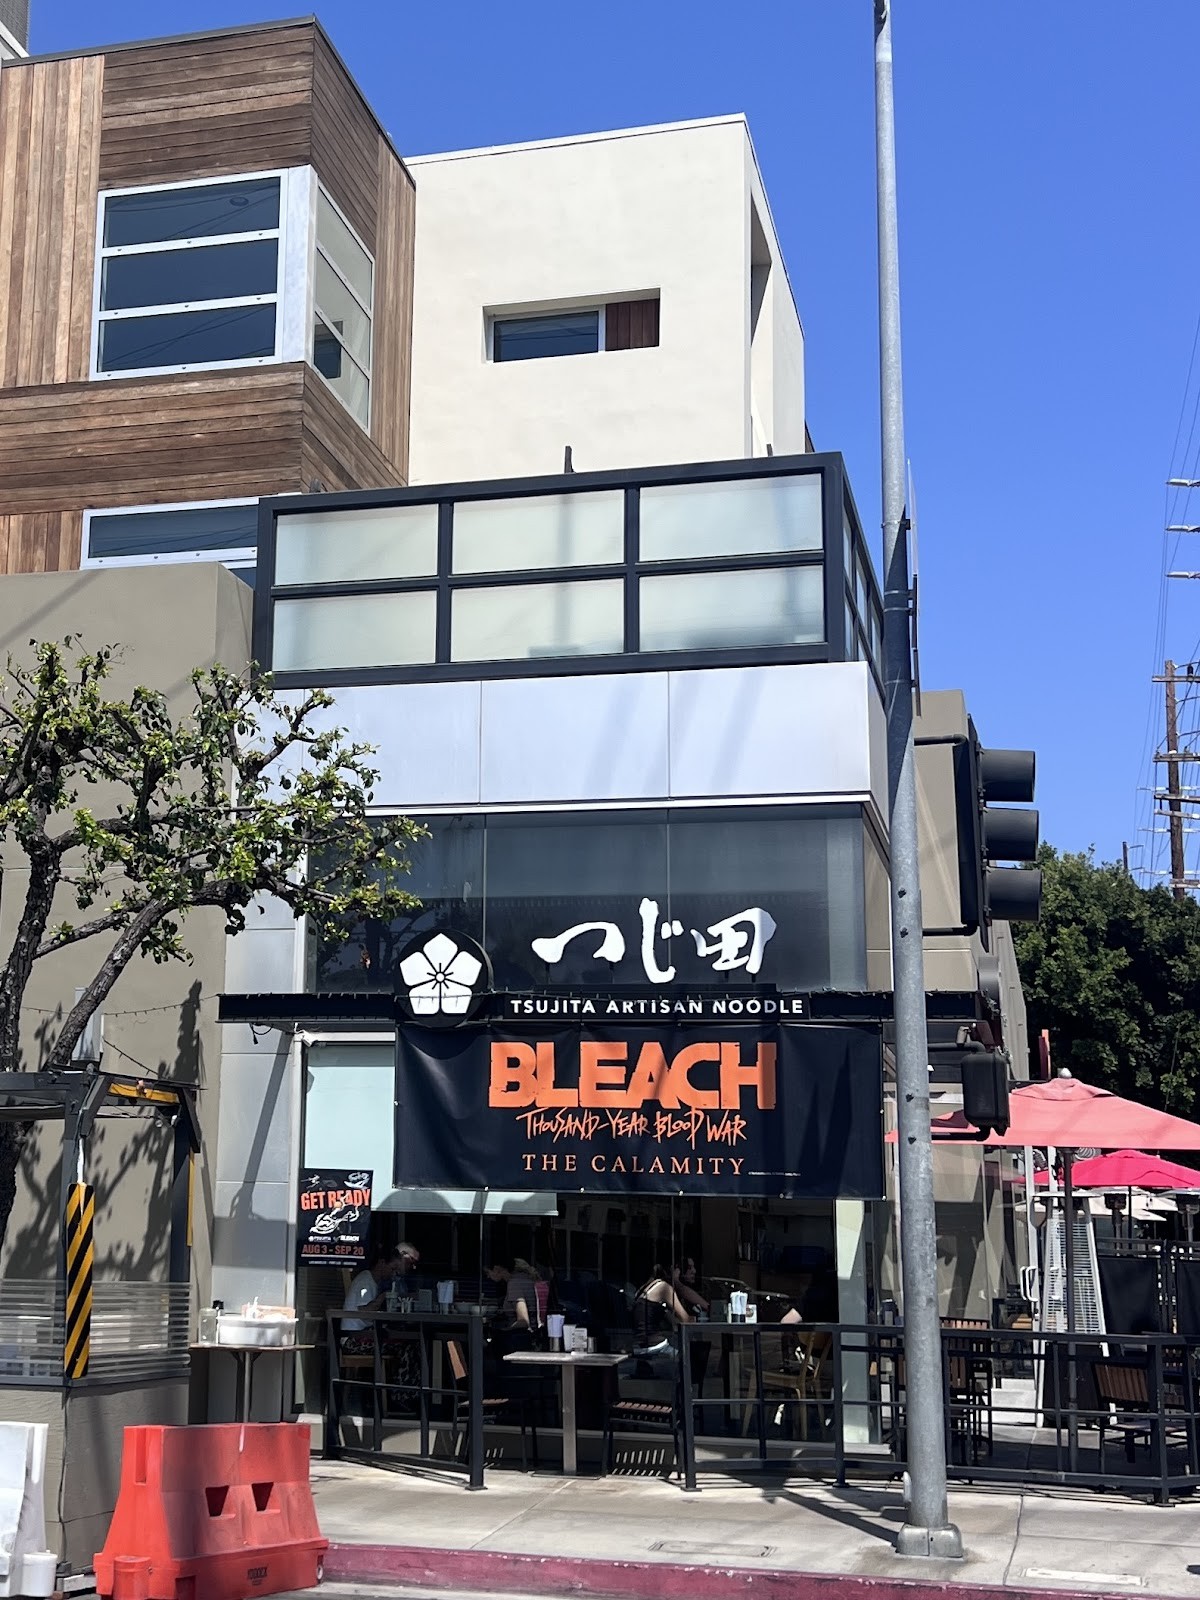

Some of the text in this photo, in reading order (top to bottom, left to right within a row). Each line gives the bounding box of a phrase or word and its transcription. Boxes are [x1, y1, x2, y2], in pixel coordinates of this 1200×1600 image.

[531, 897, 777, 984] つじ田
[510, 1000, 803, 1014] TSUJITA ARTISAN NOODLE
[488, 1041, 777, 1110] BLEACH
[652, 1106, 705, 1150] BLOOD
[706, 1109, 748, 1147] WAR
[522, 1153, 745, 1175] THE CALAMITY
[301, 1192, 325, 1210] GET
[302, 1244, 320, 1254] AUG
[321, 1245, 328, 1254] 3
[334, 1245, 352, 1255] SEP
